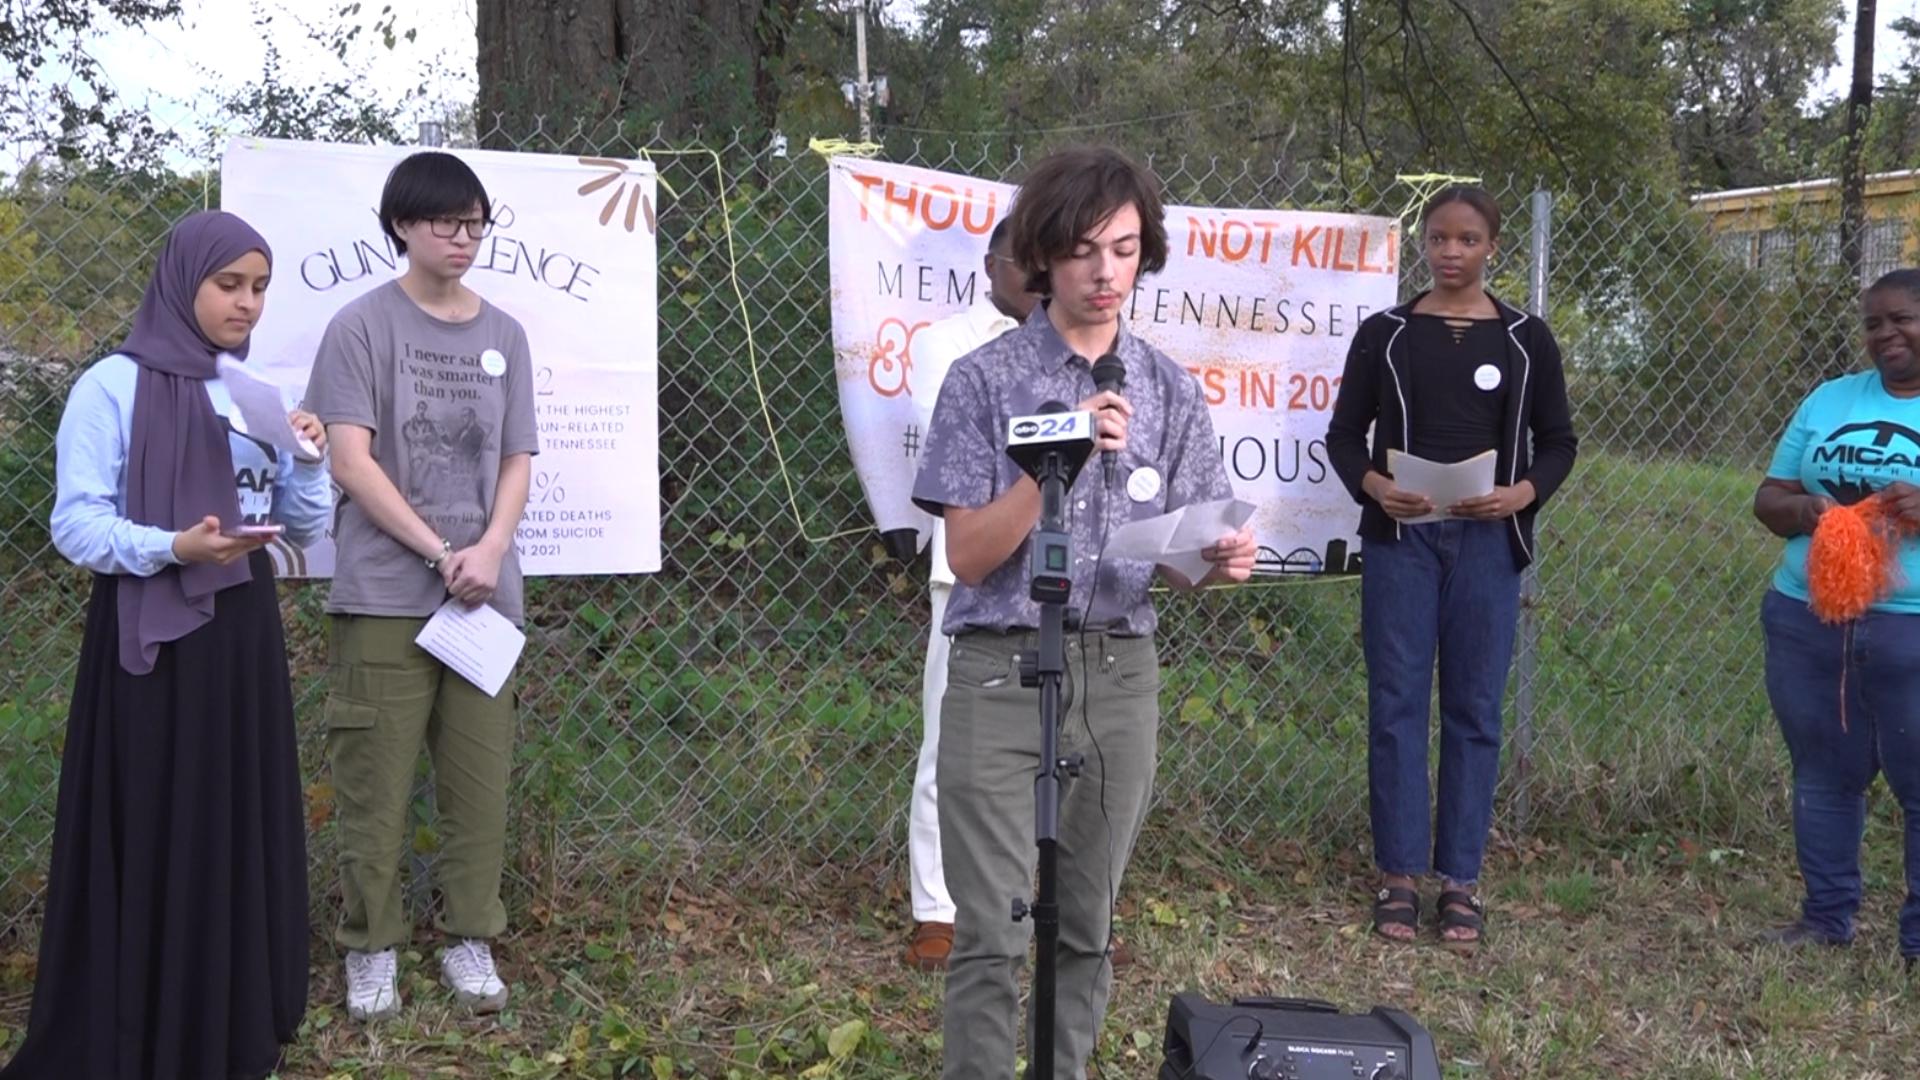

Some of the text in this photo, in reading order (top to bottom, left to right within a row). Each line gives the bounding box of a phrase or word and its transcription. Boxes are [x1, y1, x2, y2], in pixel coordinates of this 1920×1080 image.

[852, 172, 996, 234] THOU
[1187, 216, 1394, 274] NOT KILL!
[300, 234, 397, 292] GUN
[415, 349, 456, 365] never
[460, 354, 481, 367] sai
[409, 365, 433, 379] was
[437, 370, 493, 386] smarter
[414, 380, 481, 403] than you.
[1239, 370, 1275, 408] IN
[547, 405, 567, 416] THE
[574, 405, 630, 416] HIGHEST
[1040, 416, 1076, 437] 24
[546, 438, 617, 450] TENNESSEE
[1812, 444, 1920, 468] MICA
[560, 510, 612, 522] DEATHS
[516, 528, 604, 540] ROM SUICIDE
[531, 545, 561, 557] 2021
